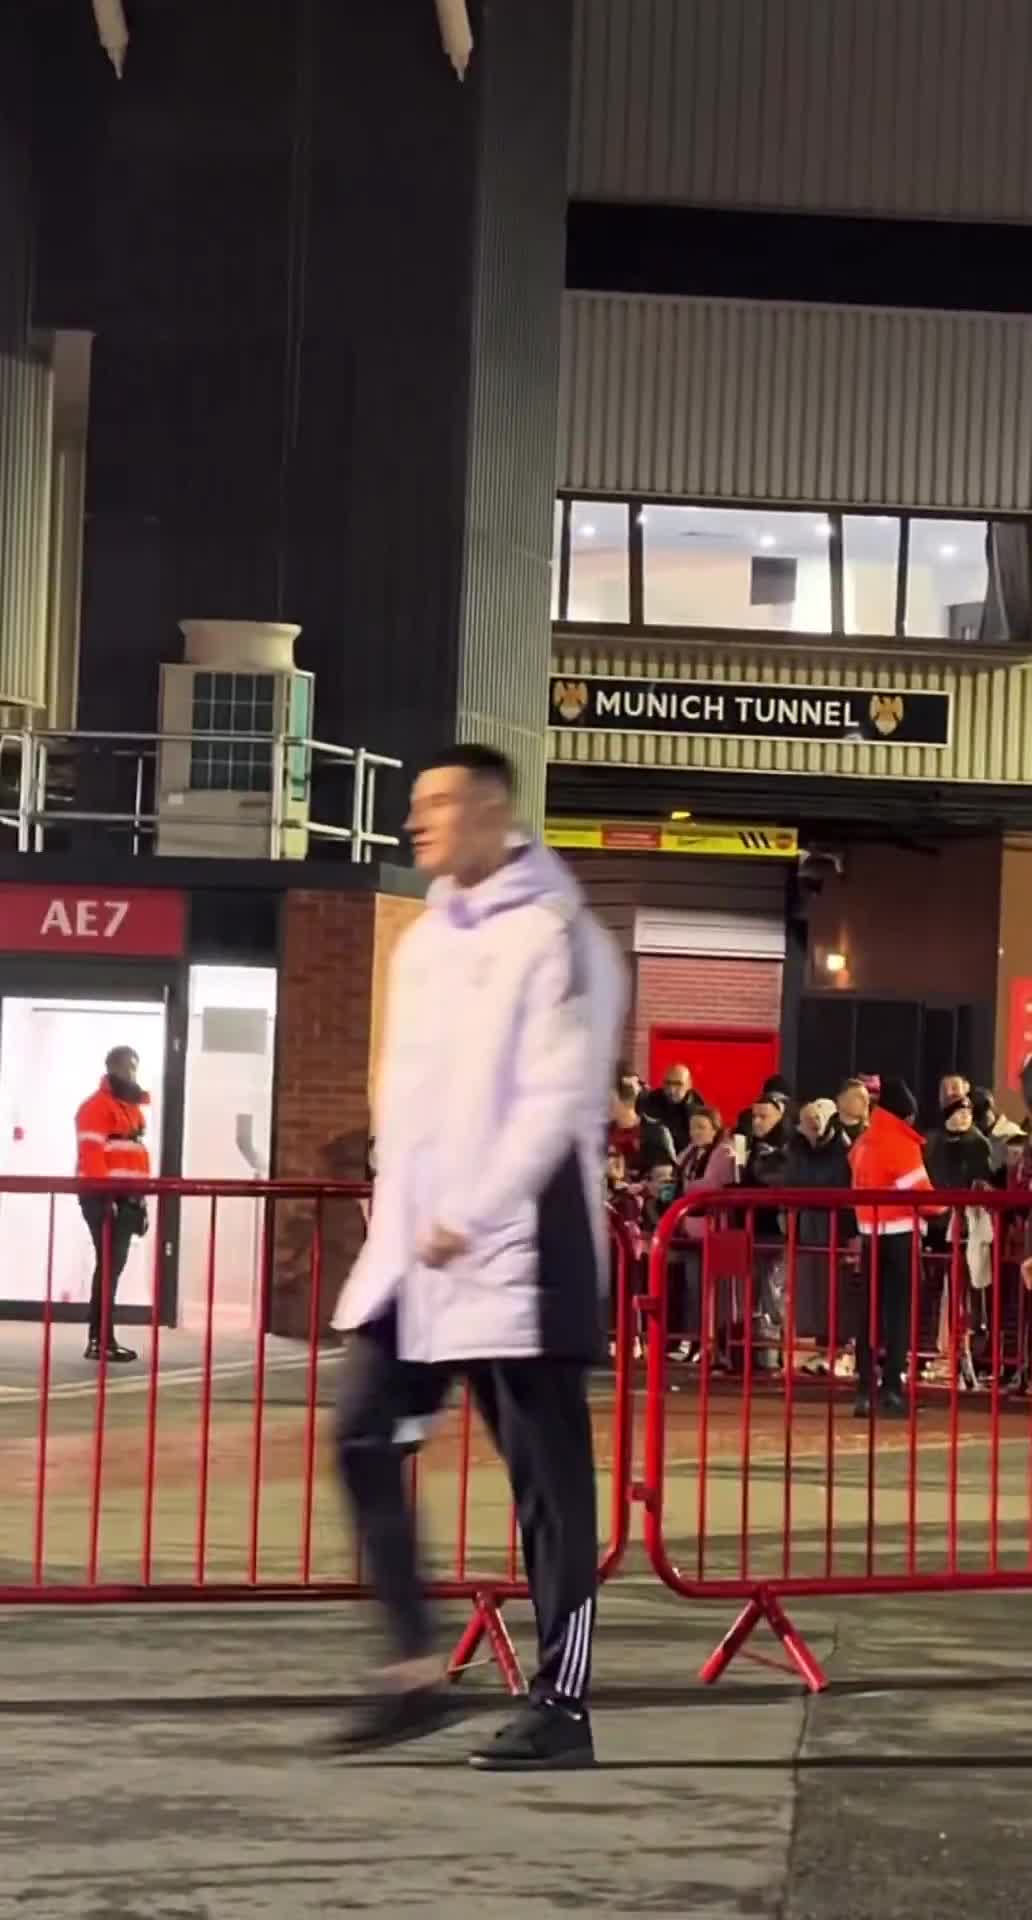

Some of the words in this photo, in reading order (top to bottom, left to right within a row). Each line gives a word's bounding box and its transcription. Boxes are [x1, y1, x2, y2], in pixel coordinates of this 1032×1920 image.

[595, 690, 724, 722] MUNICH
[735, 697, 860, 728] TUNNEL
[40, 899, 130, 937] AE7
